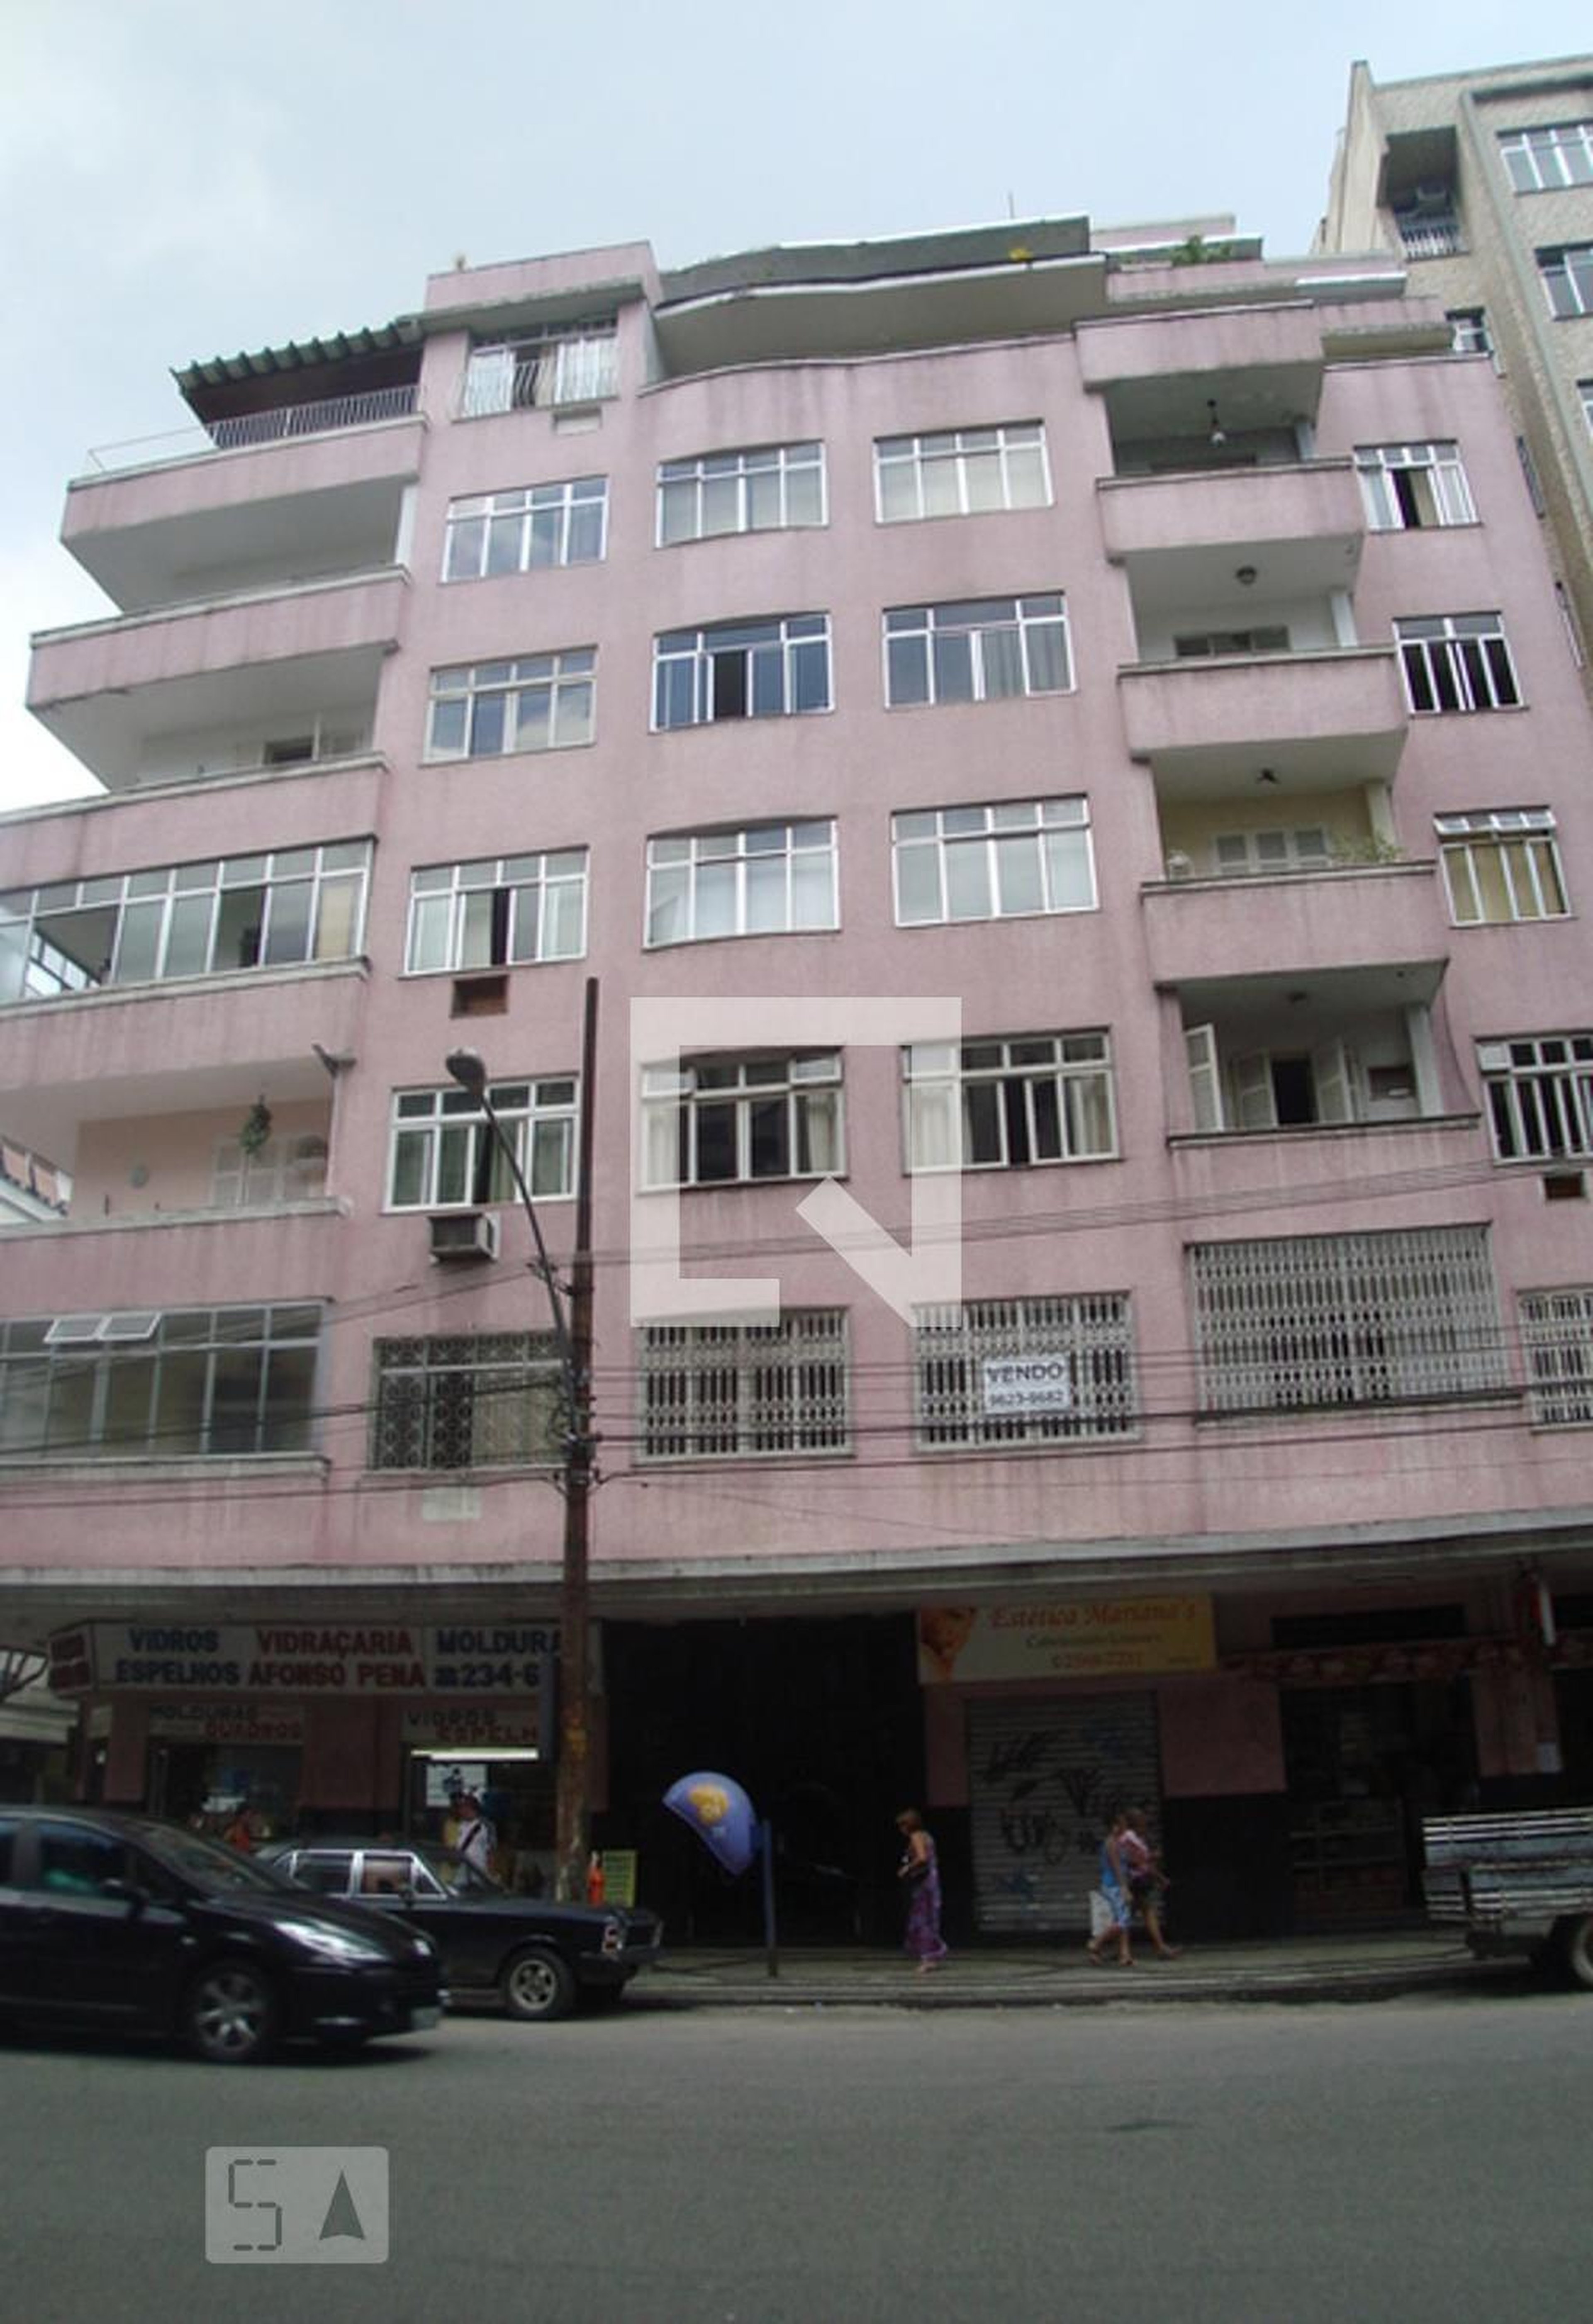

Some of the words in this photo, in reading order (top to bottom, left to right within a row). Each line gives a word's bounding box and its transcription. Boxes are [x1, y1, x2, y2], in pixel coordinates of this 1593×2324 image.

[987, 1362, 1063, 1382] VENDO
[129, 1629, 218, 1653] VIDROS
[258, 1629, 412, 1658] VIDRAÇARIA
[115, 1661, 239, 1685] ESPELHOS
[248, 1662, 346, 1686] AFONSO
[357, 1662, 424, 1687] PENA
[409, 1708, 497, 1726] VIDROS
